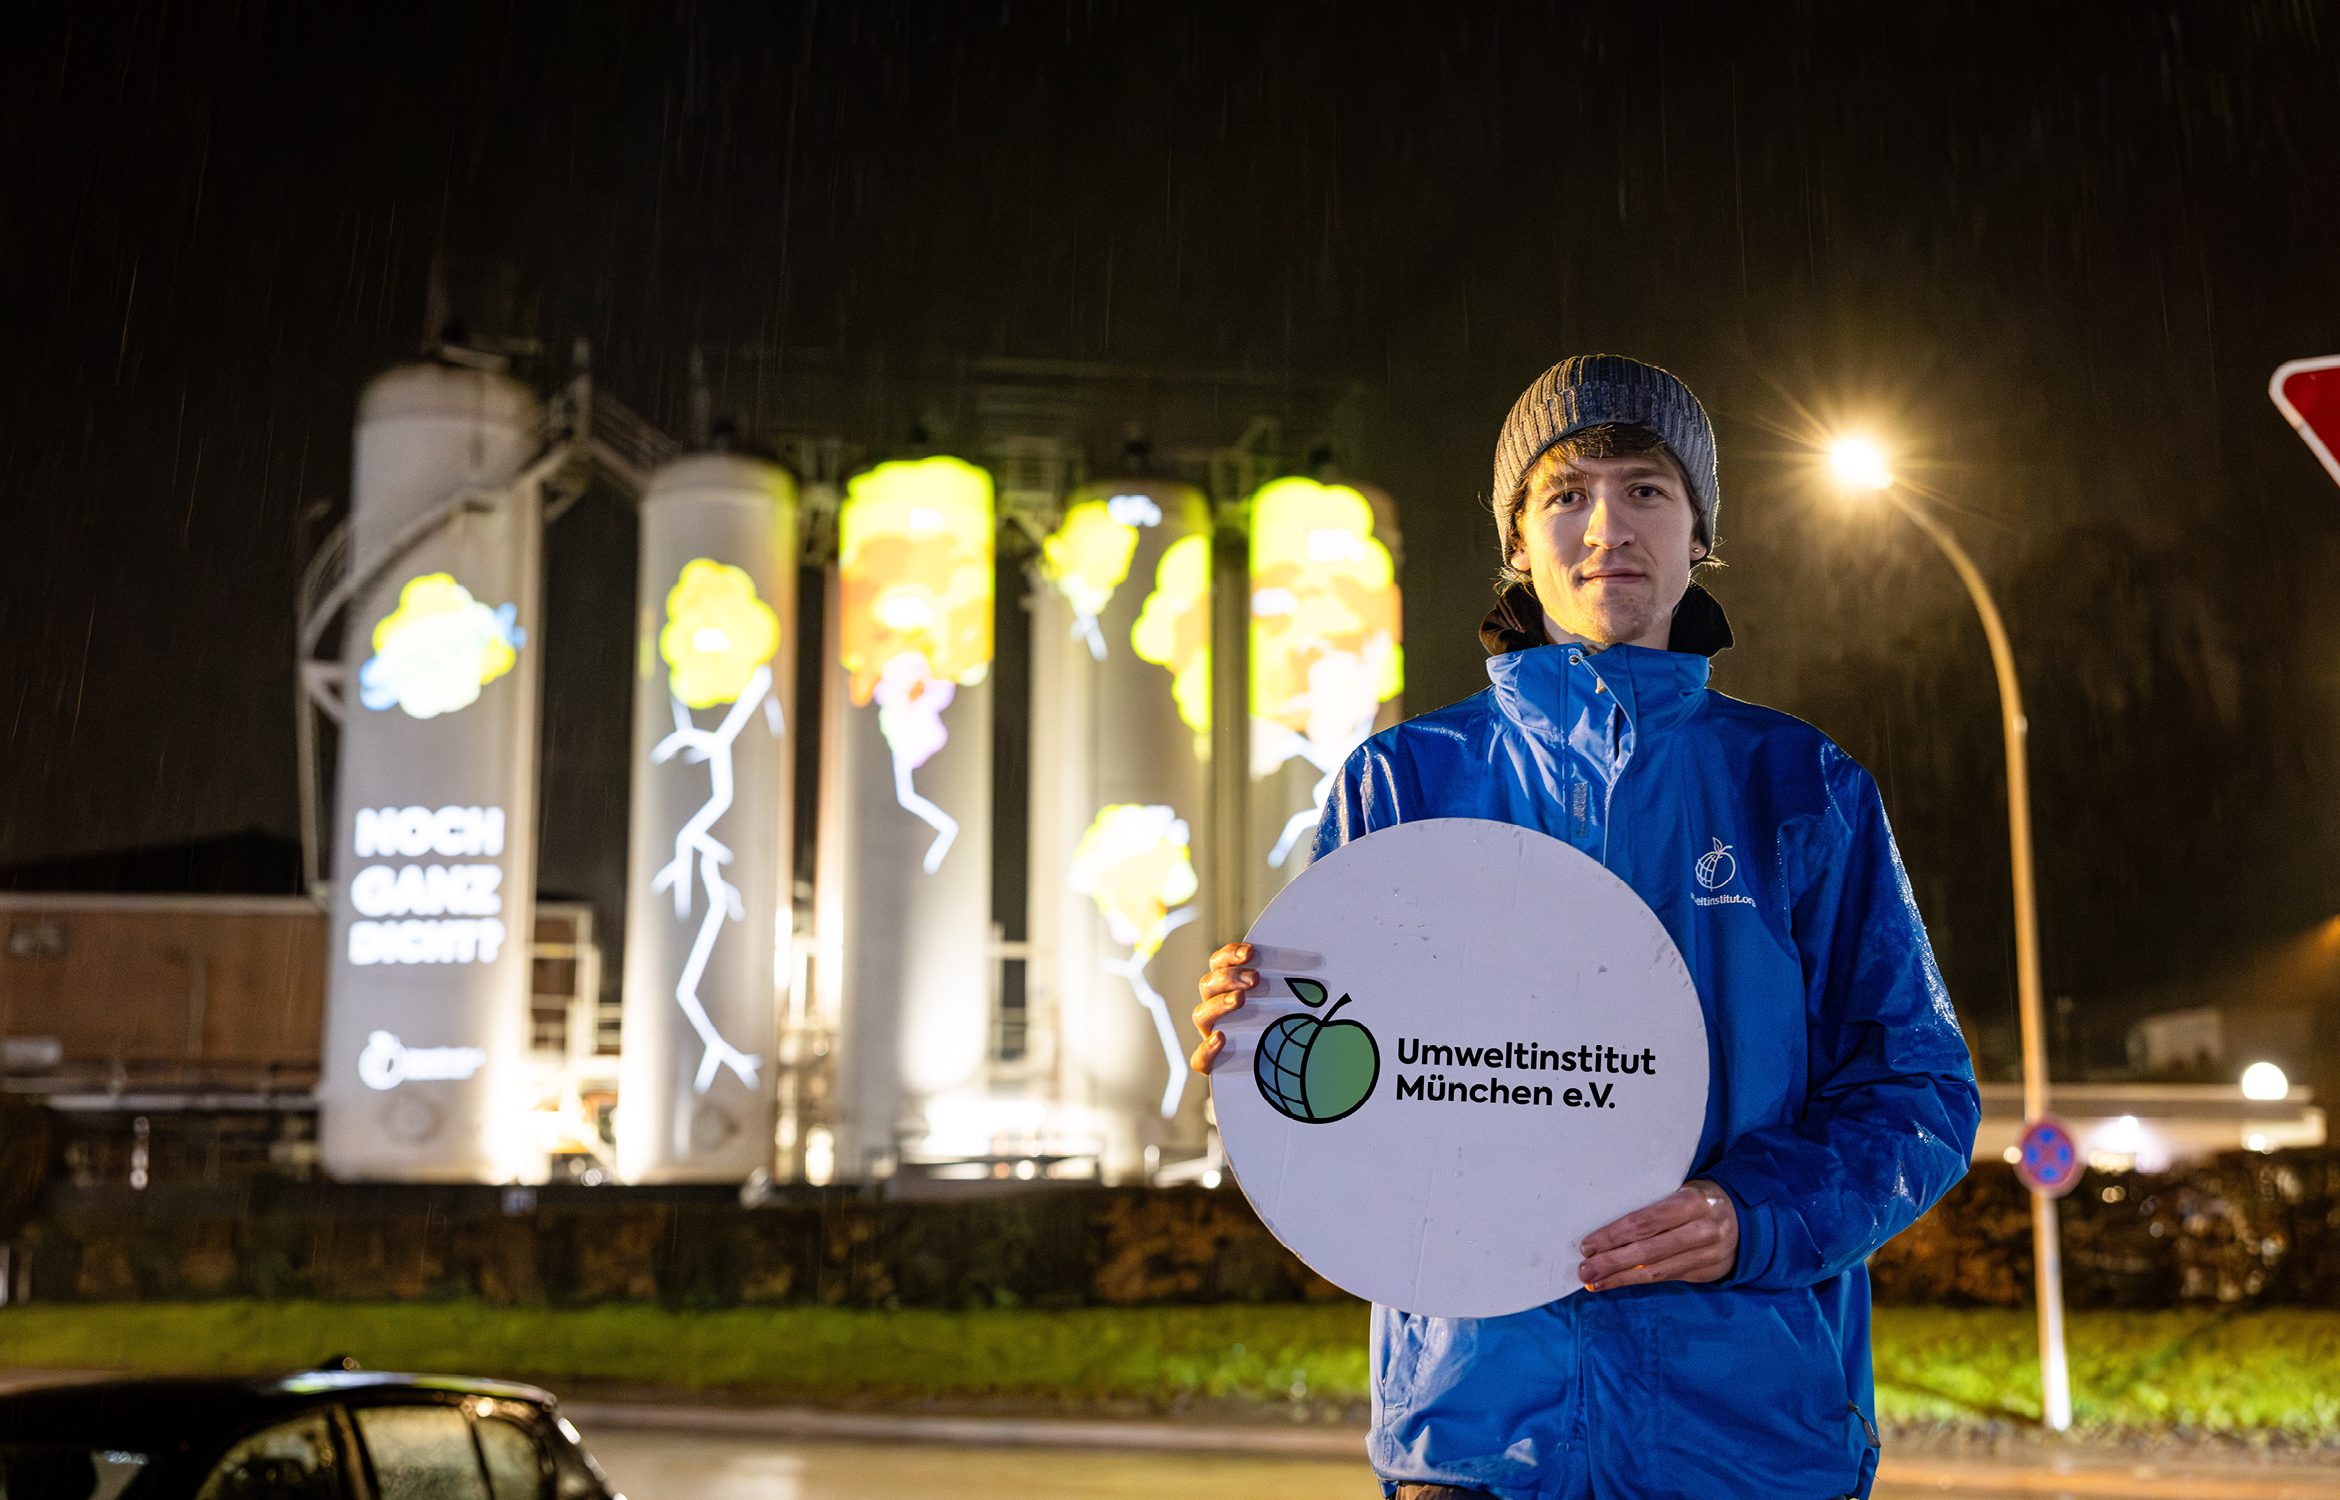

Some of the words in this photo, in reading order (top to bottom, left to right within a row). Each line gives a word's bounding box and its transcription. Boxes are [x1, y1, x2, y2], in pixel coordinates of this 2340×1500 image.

[355, 806, 505, 857] NOCH
[351, 864, 502, 917] GANZ
[1397, 1037, 1656, 1075] Umweltinstitut
[1396, 1074, 1553, 1106] München
[1562, 1082, 1616, 1109] e.V.
